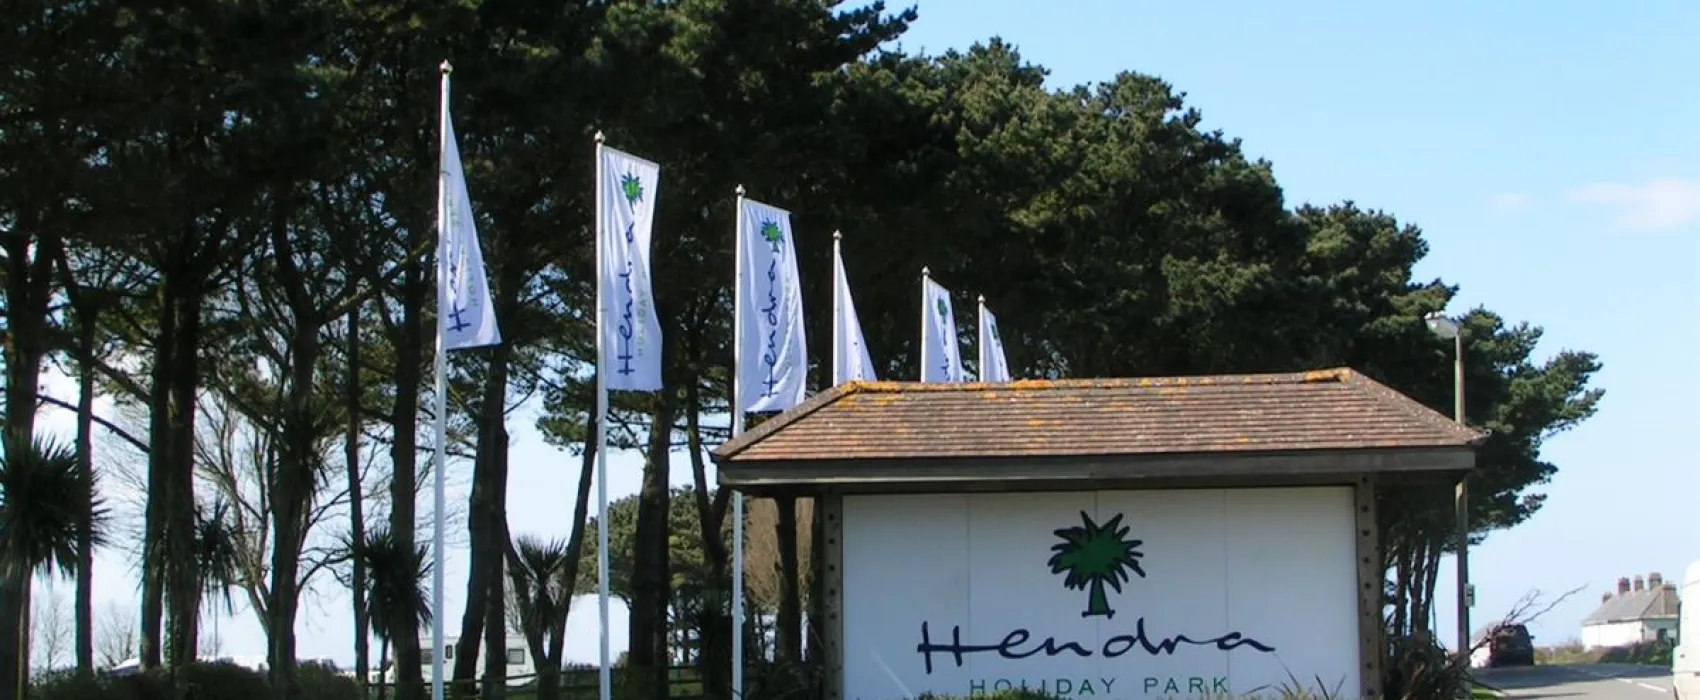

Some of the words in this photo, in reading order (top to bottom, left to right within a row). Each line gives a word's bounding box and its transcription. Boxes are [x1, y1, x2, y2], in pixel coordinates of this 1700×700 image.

[617, 220, 636, 376] Henda
[760, 258, 779, 398] Hendra
[916, 617, 1276, 674] Hendra
[1143, 676, 1229, 695] PARK
